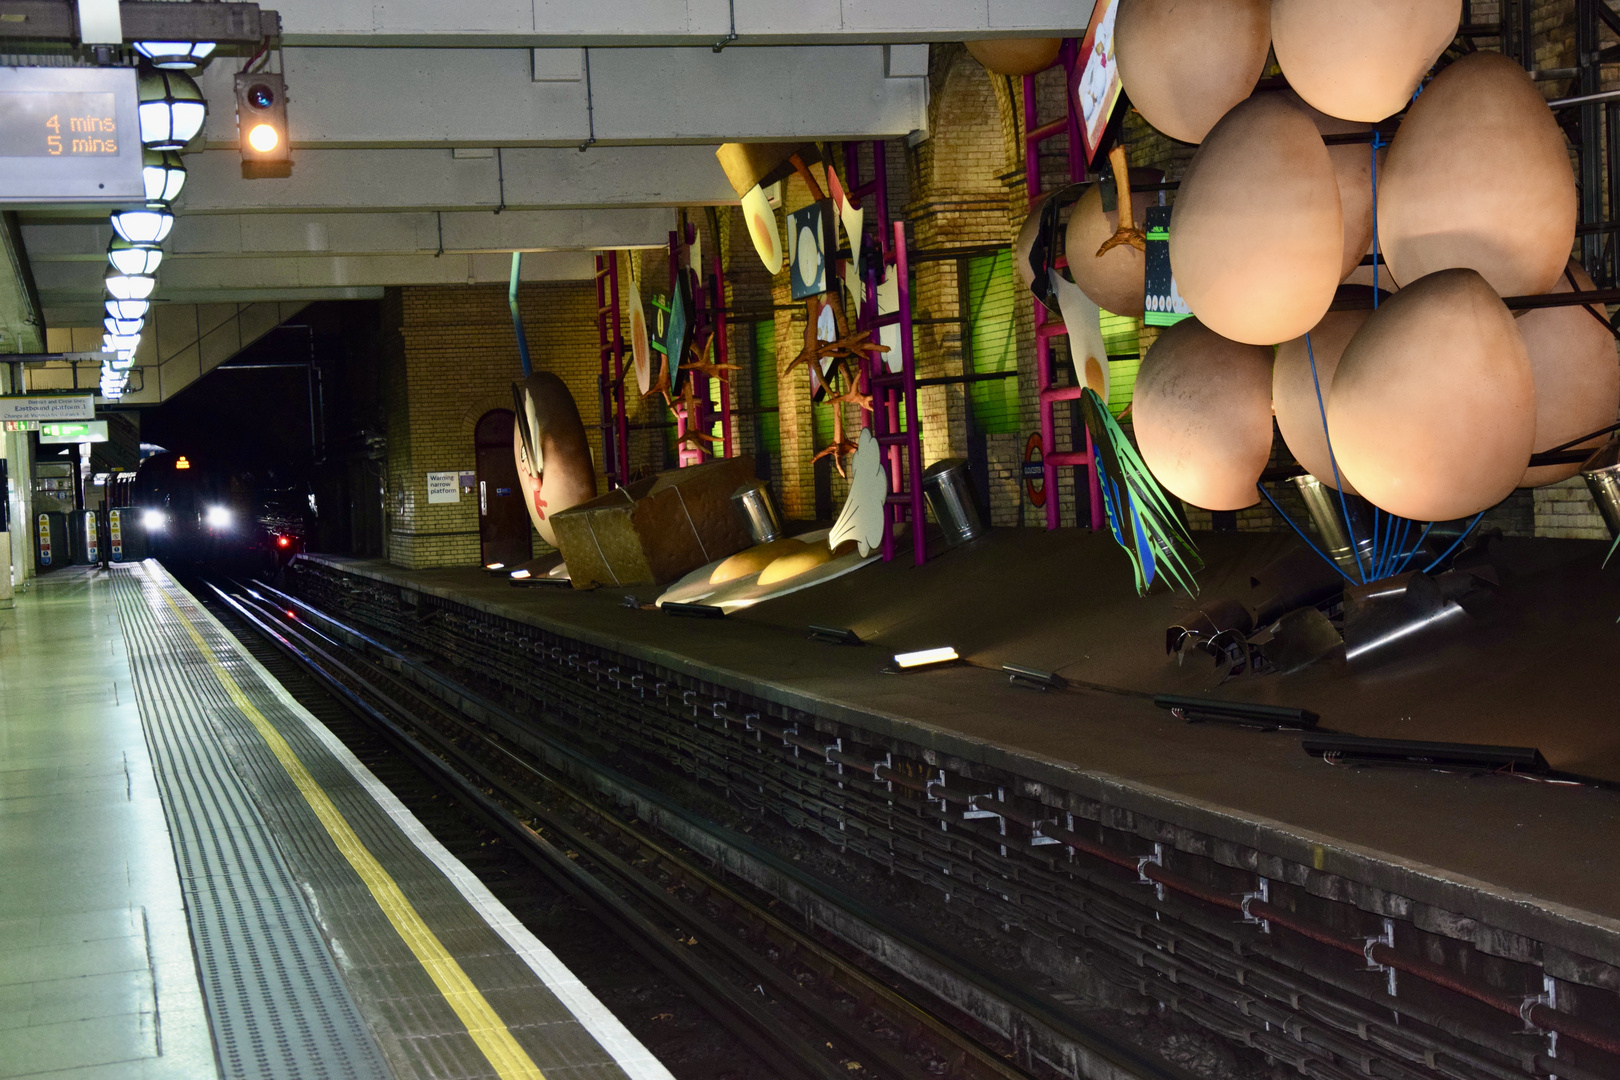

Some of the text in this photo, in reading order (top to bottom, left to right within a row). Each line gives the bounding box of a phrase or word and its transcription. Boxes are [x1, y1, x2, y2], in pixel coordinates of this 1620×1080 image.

[46, 115, 115, 133] 4 mins
[47, 136, 117, 155] 5 mins
